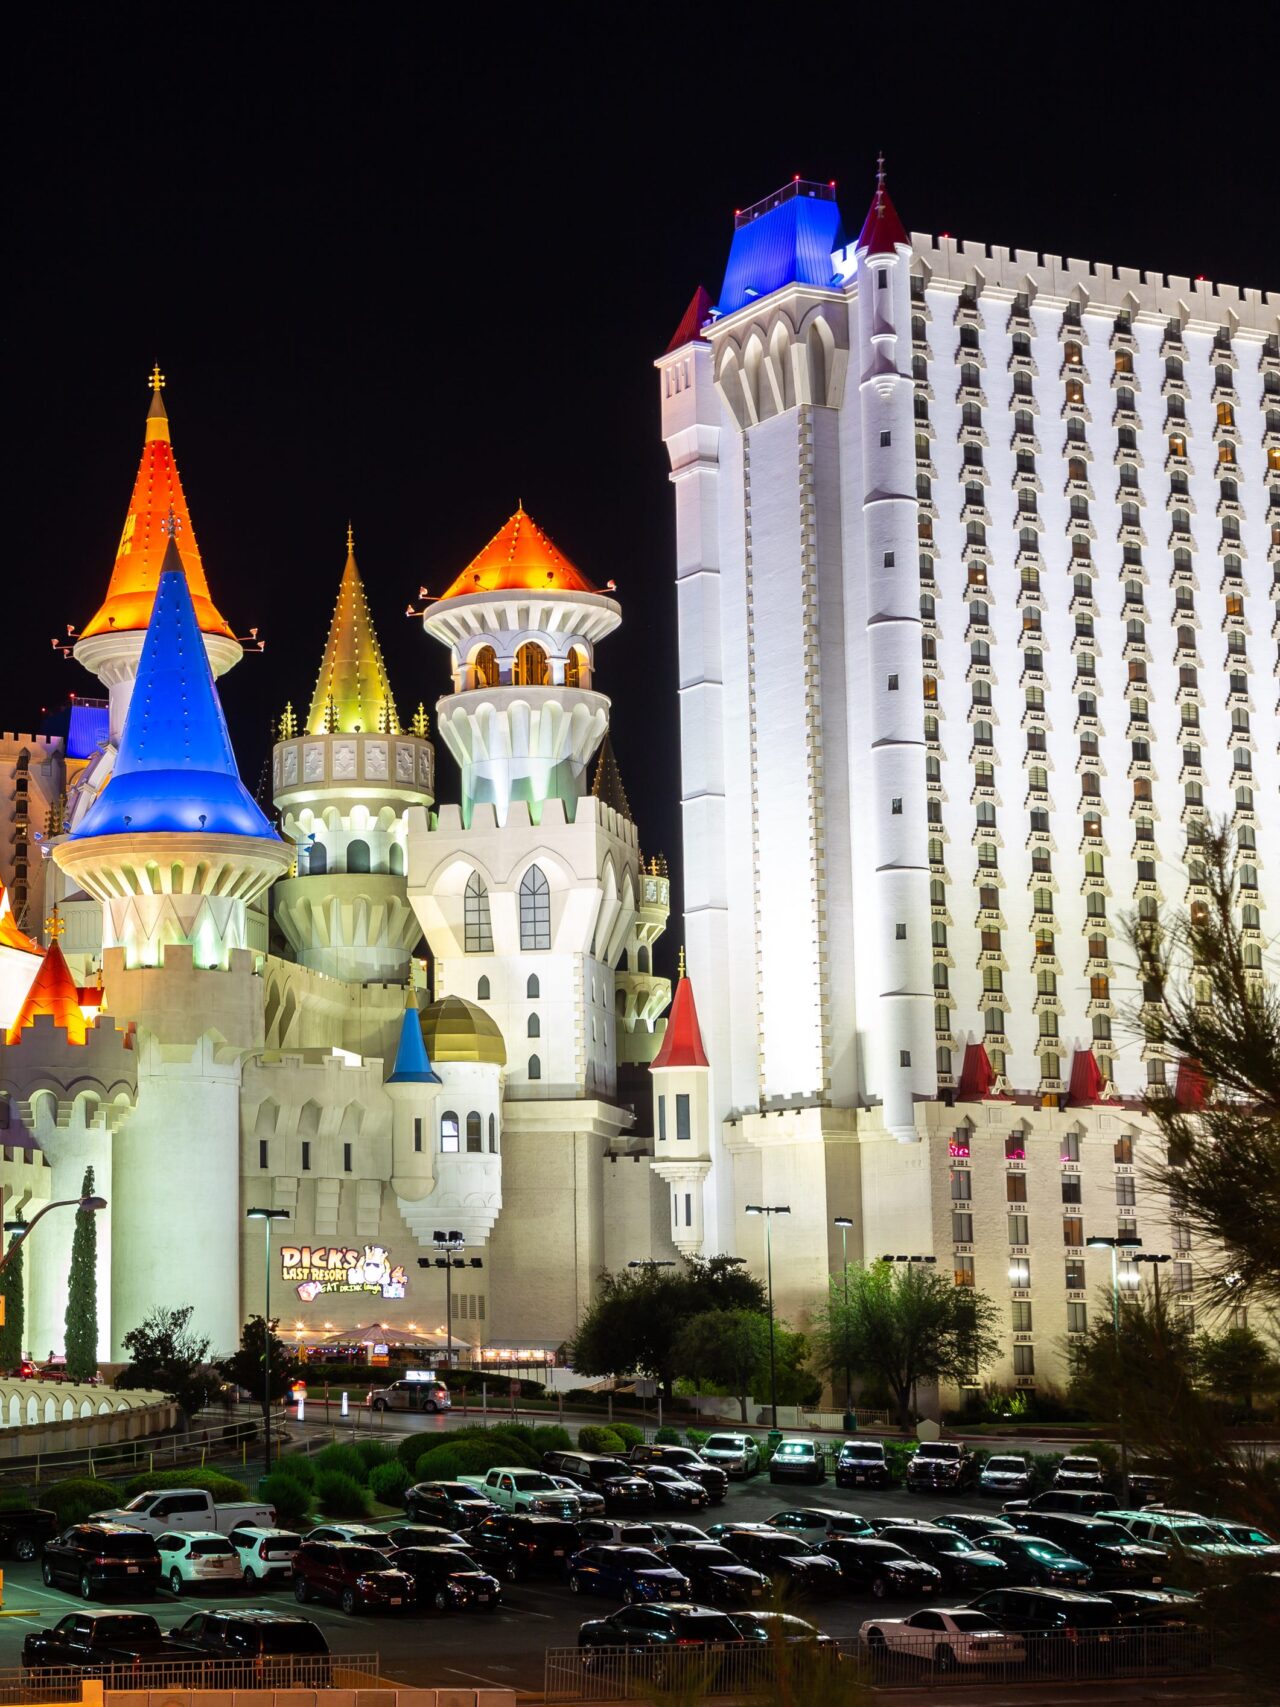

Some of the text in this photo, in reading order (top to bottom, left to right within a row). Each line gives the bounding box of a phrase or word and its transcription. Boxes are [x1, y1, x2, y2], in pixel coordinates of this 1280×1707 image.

[281, 1247, 358, 1269] DICK'S
[282, 1268, 347, 1281] LAST RESORT
[320, 1282, 339, 1293] EAT
[340, 1284, 363, 1292] DRINK
